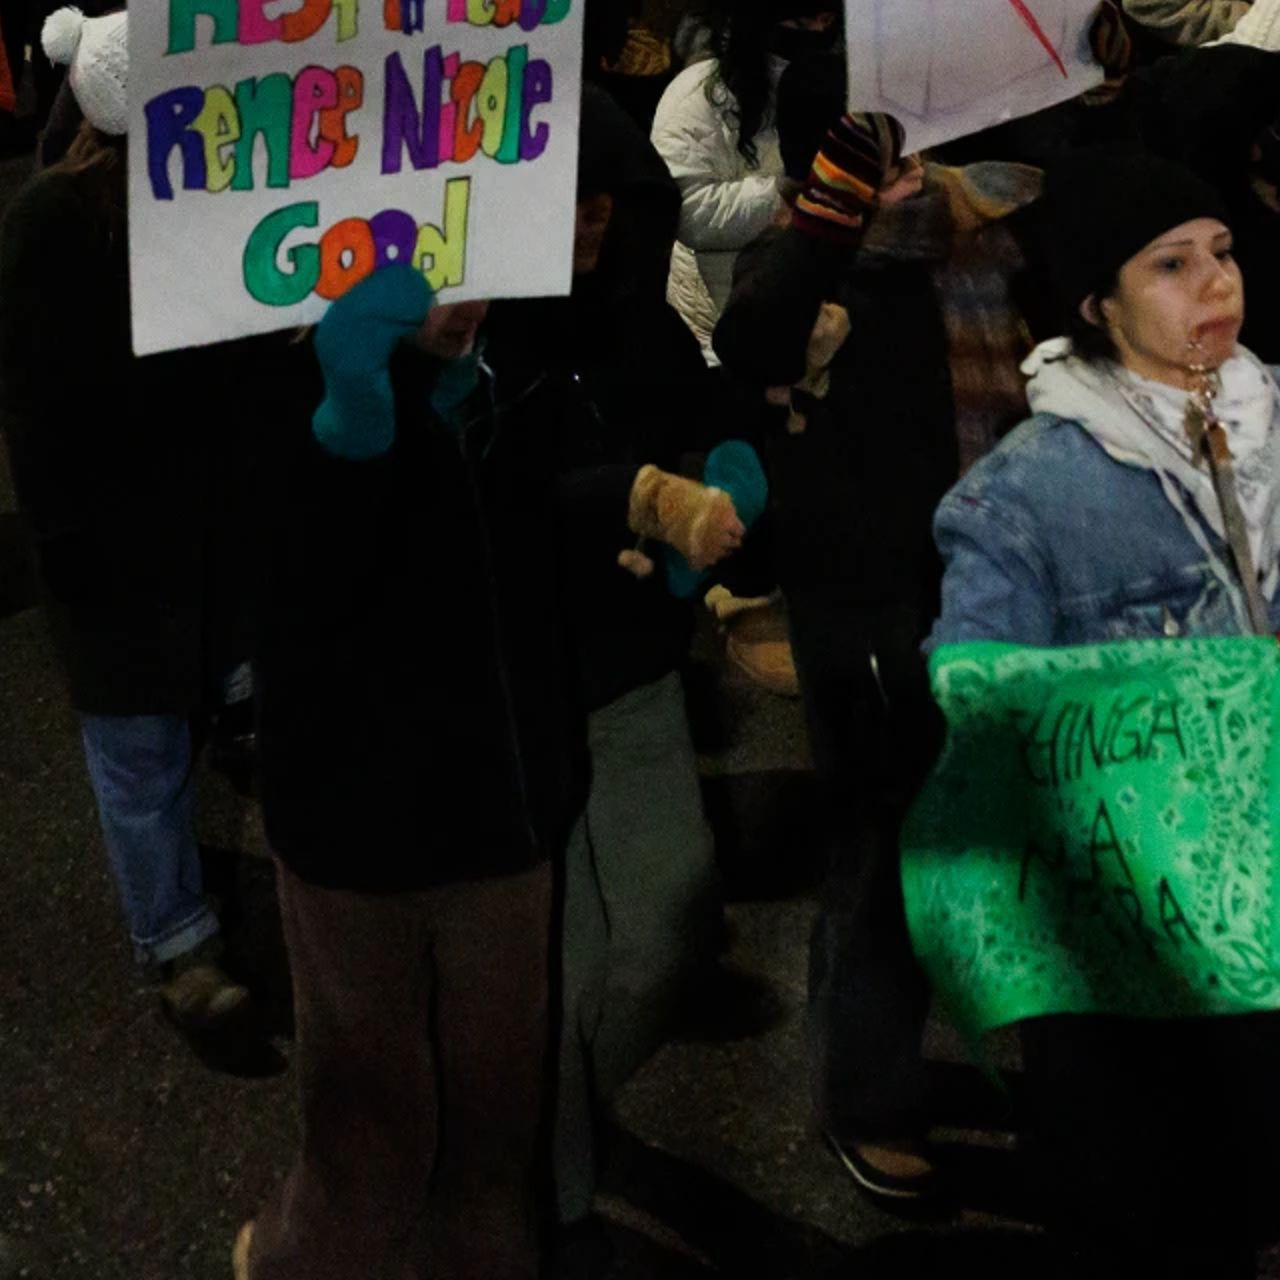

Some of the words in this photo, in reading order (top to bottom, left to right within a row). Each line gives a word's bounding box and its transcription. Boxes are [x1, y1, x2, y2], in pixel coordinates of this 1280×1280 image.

[143, 64, 364, 201] Renee
[380, 44, 553, 174] Nicole
[243, 176, 471, 306] Good
